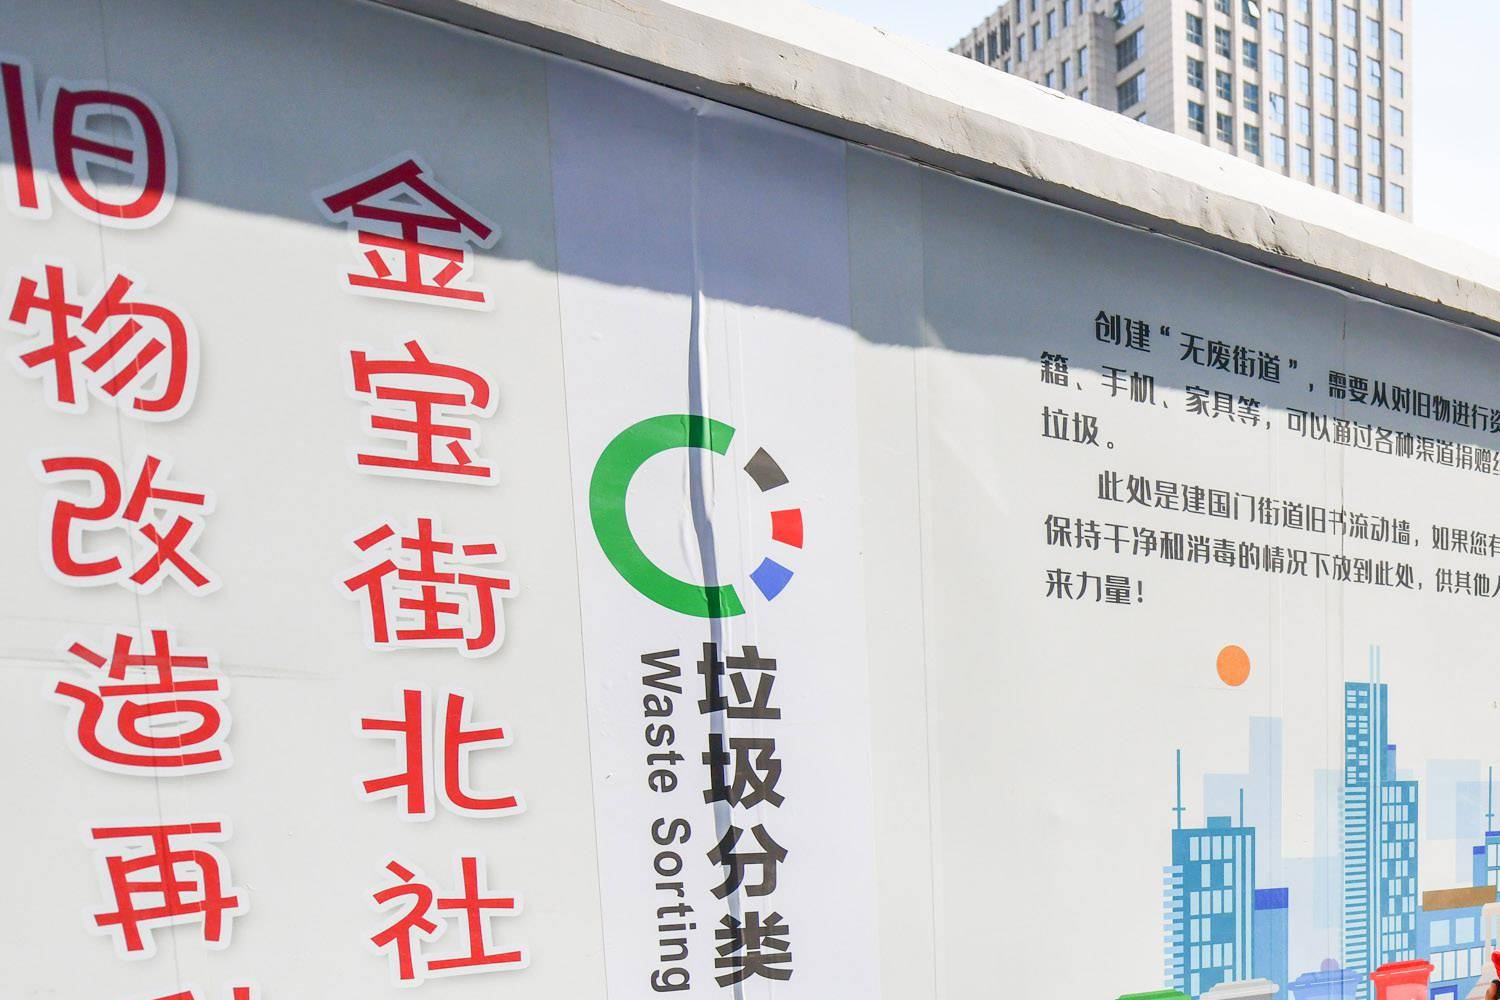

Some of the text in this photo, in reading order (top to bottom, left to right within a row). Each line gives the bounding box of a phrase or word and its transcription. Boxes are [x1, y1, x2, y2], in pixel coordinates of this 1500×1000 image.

[1041, 406, 1115, 450] 垃圾。
[640, 648, 697, 993] Waste Sorting
[697, 642, 793, 988] 垃圾分类
